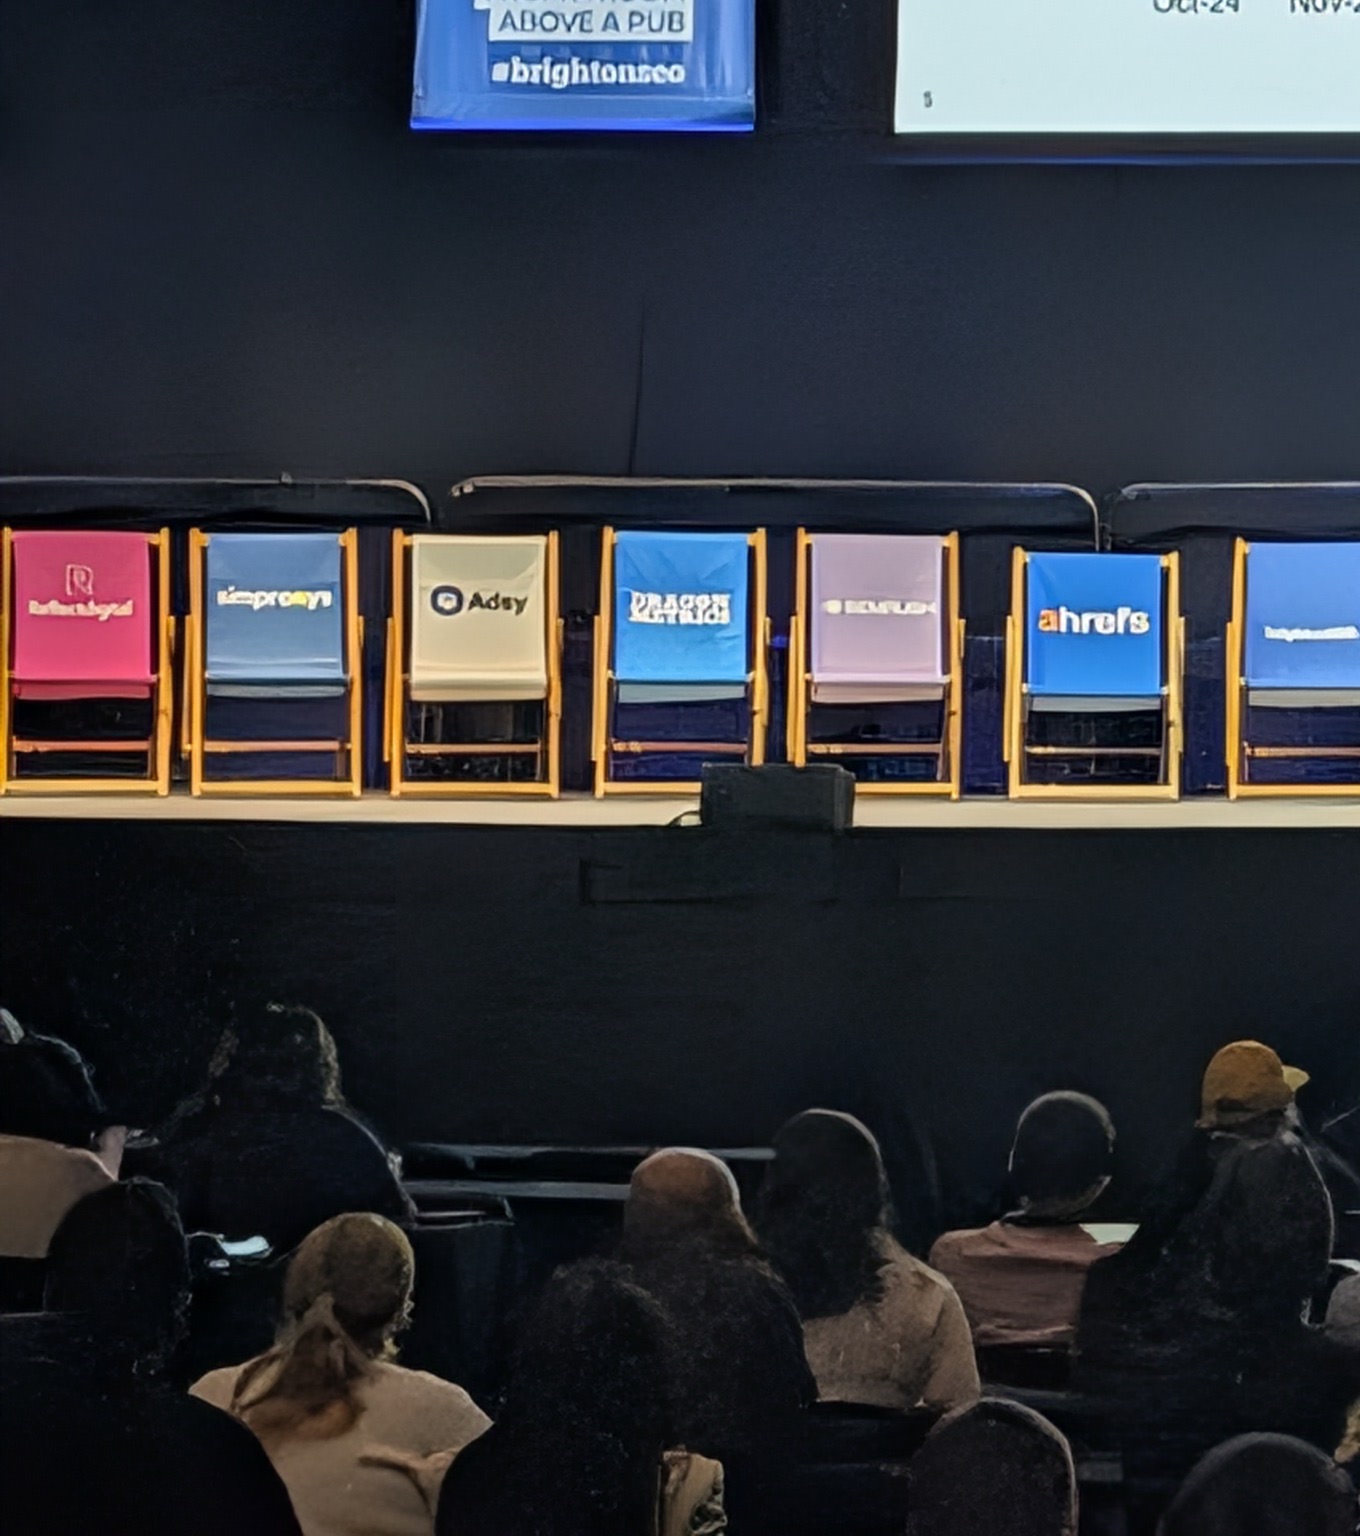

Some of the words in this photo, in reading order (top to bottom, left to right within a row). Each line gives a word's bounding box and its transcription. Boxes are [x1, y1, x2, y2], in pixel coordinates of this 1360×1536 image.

[499, 9, 594, 33] ABOVE
[601, 9, 620, 33] A
[629, 9, 685, 33] PUB
[1039, 606, 1150, 635] ahrefs
